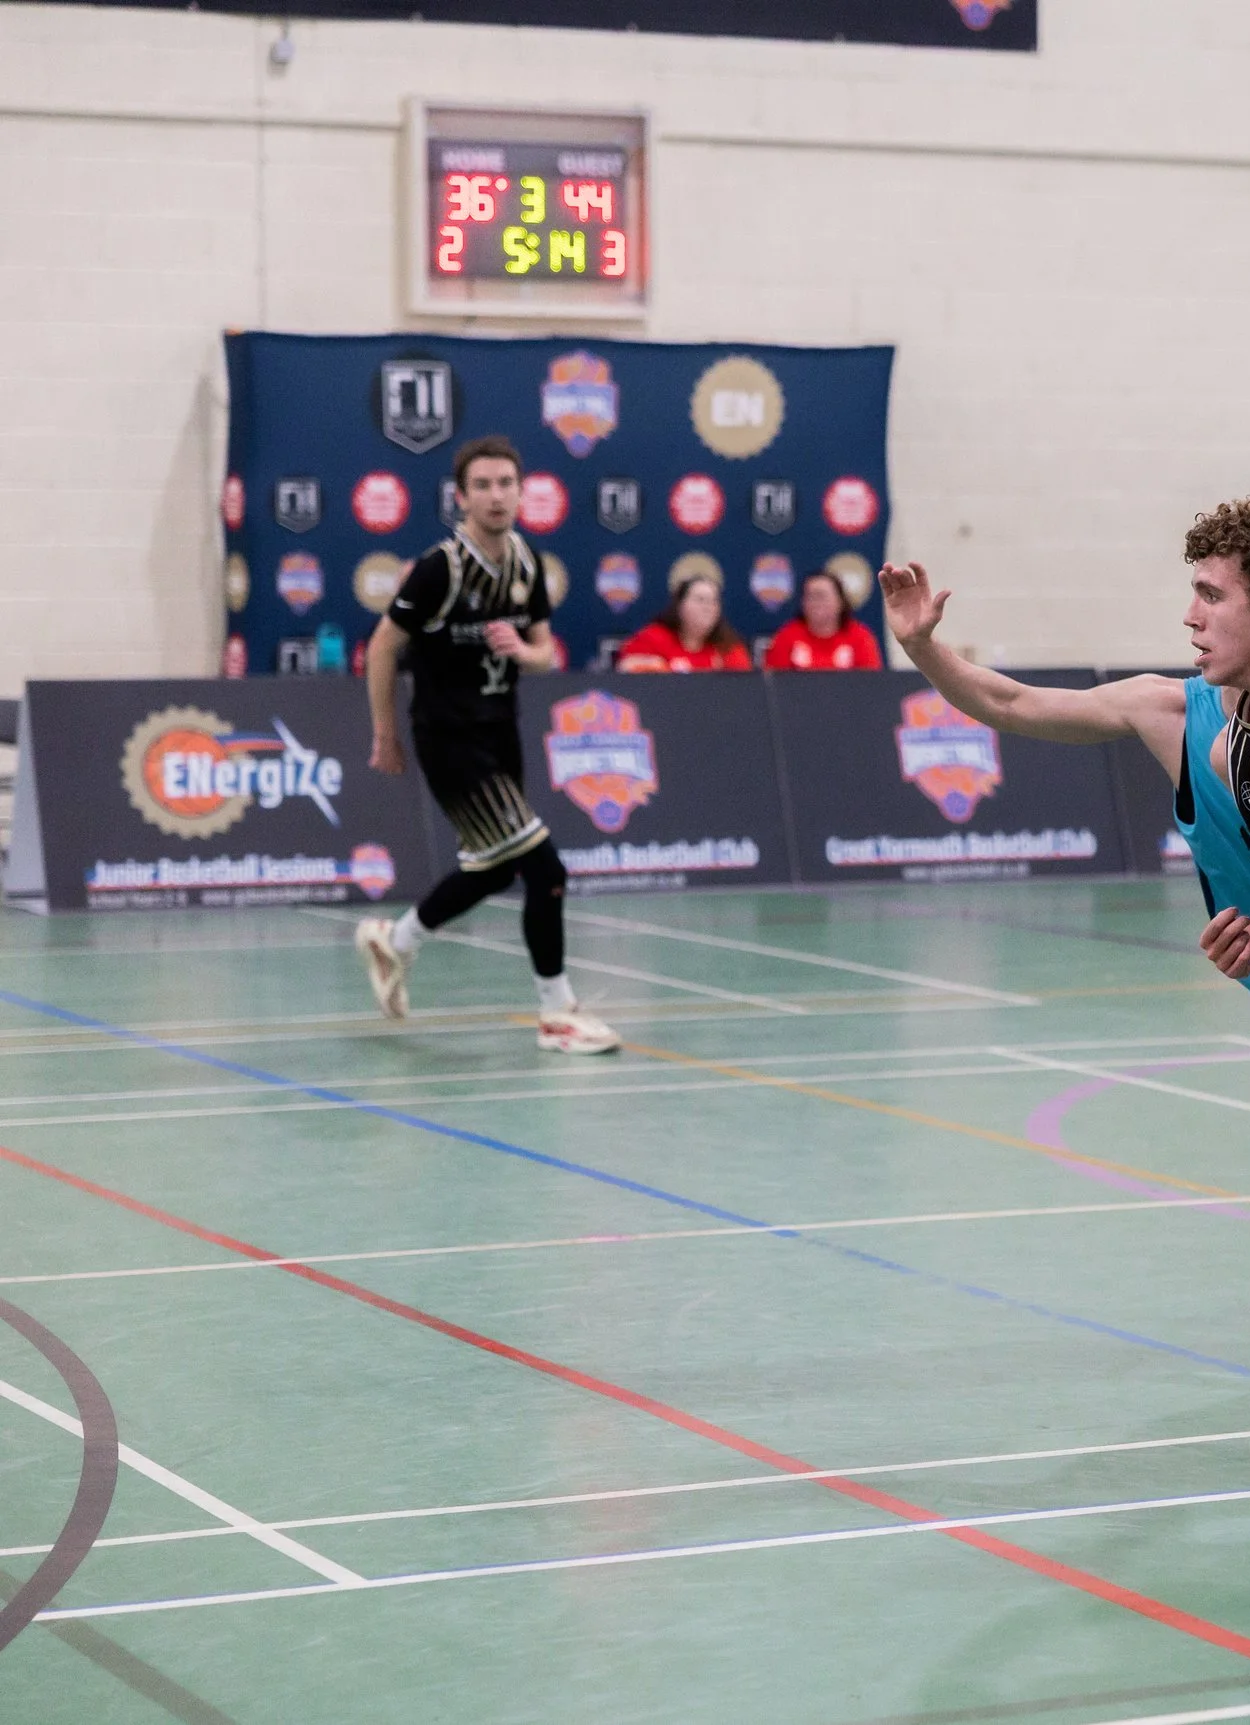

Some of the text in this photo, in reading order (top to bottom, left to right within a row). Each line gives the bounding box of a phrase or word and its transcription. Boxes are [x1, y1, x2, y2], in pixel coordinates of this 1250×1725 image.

[447, 174, 496, 222] 36
[519, 175, 546, 224] 3
[563, 179, 615, 223] 44
[438, 225, 465, 272] 2
[601, 230, 627, 276] 3
[711, 390, 764, 427] EN
[618, 839, 712, 868] Basketball
[965, 829, 1053, 859] Basketball
